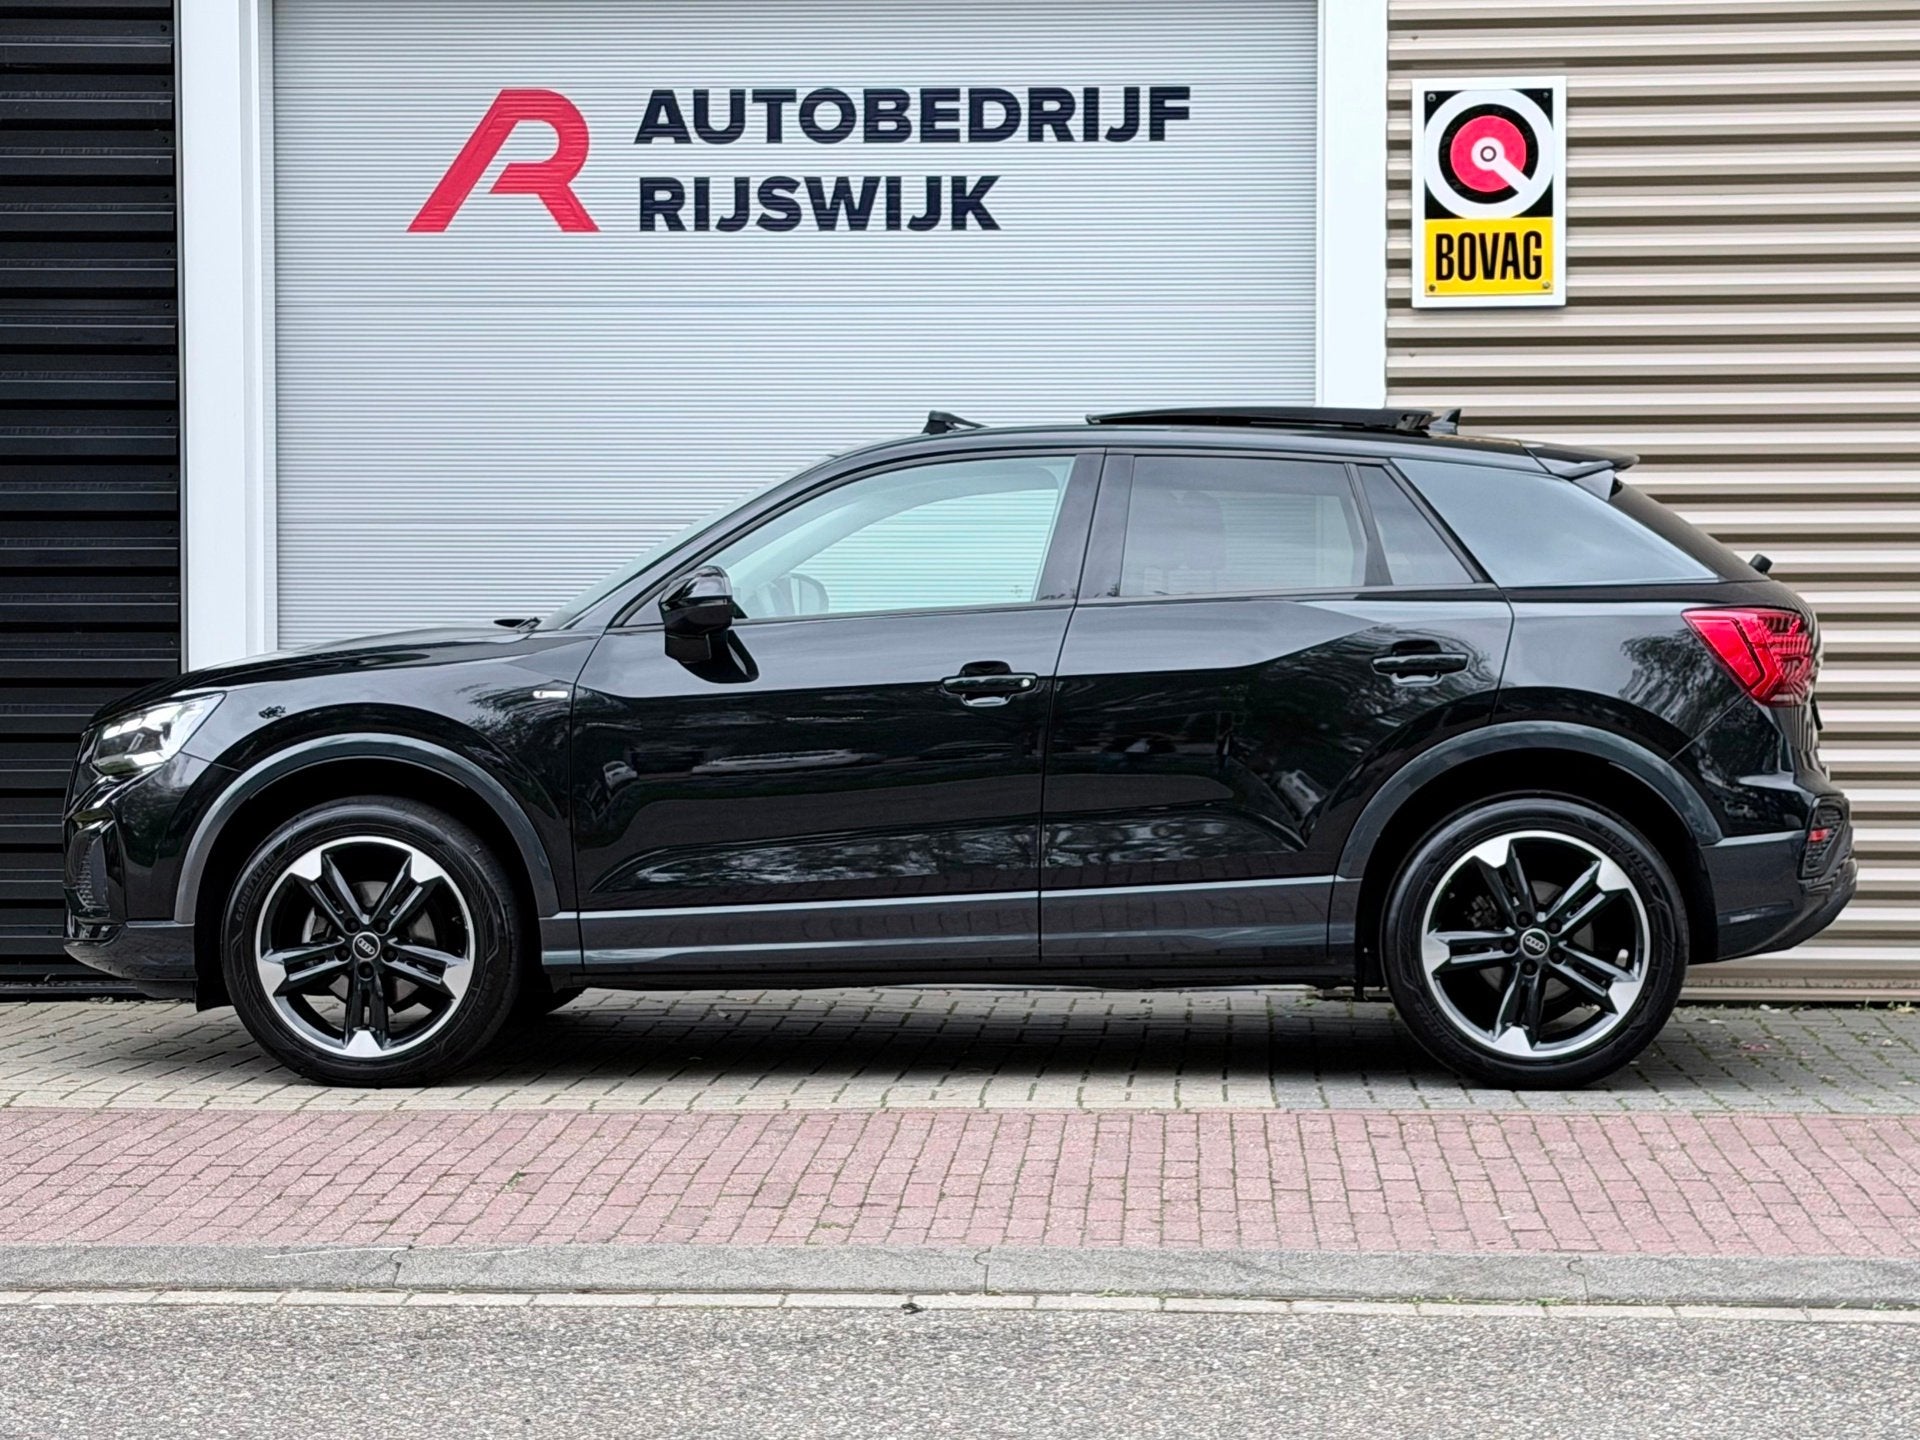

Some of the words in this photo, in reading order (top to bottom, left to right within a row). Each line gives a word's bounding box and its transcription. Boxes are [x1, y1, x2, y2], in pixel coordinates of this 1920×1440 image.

[634, 86, 1190, 144] AUTOBEDRIJF
[639, 176, 1001, 232] RIJSWIJK
[1436, 230, 1543, 281] BOVAG
